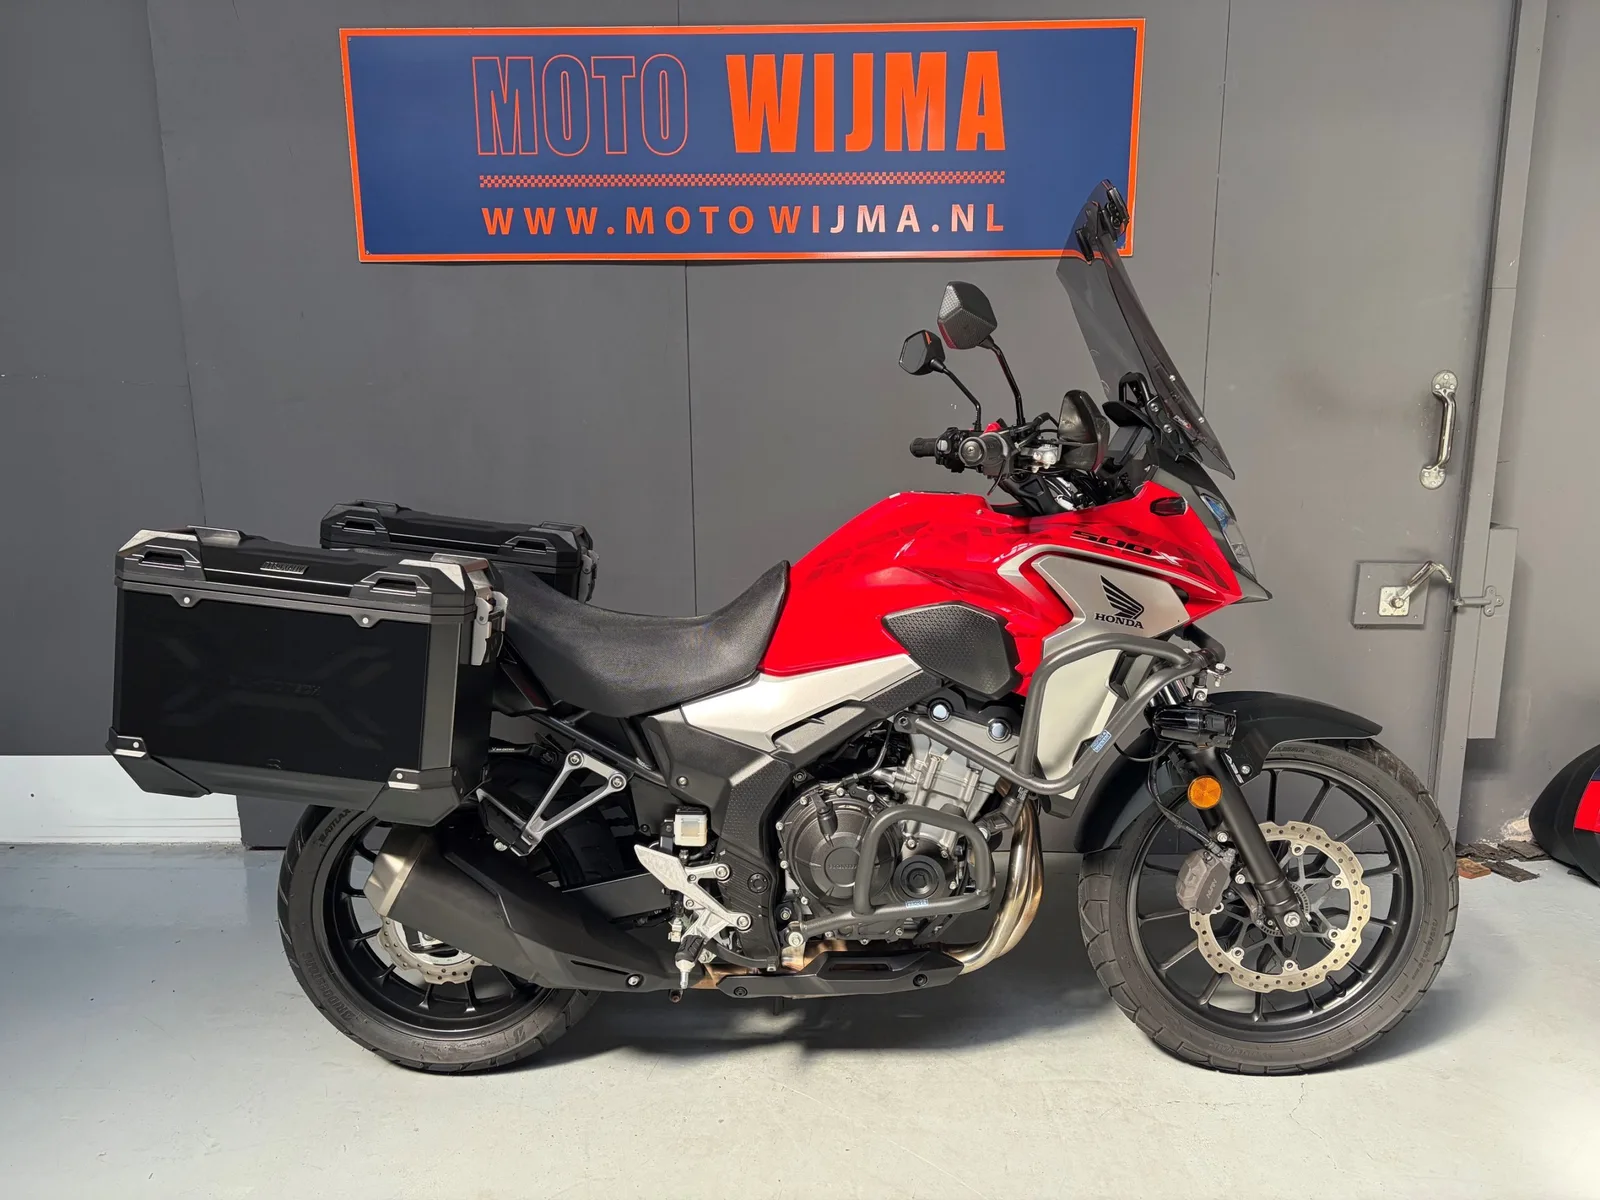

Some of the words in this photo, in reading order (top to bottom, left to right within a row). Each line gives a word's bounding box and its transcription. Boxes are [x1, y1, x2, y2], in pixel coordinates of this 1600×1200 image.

[472, 54, 688, 157] MOTO
[726, 51, 1006, 153] WIJMA
[481, 204, 1004, 235] WWW.MOTOWIJMA.NL
[1094, 612, 1144, 630] HONDA
